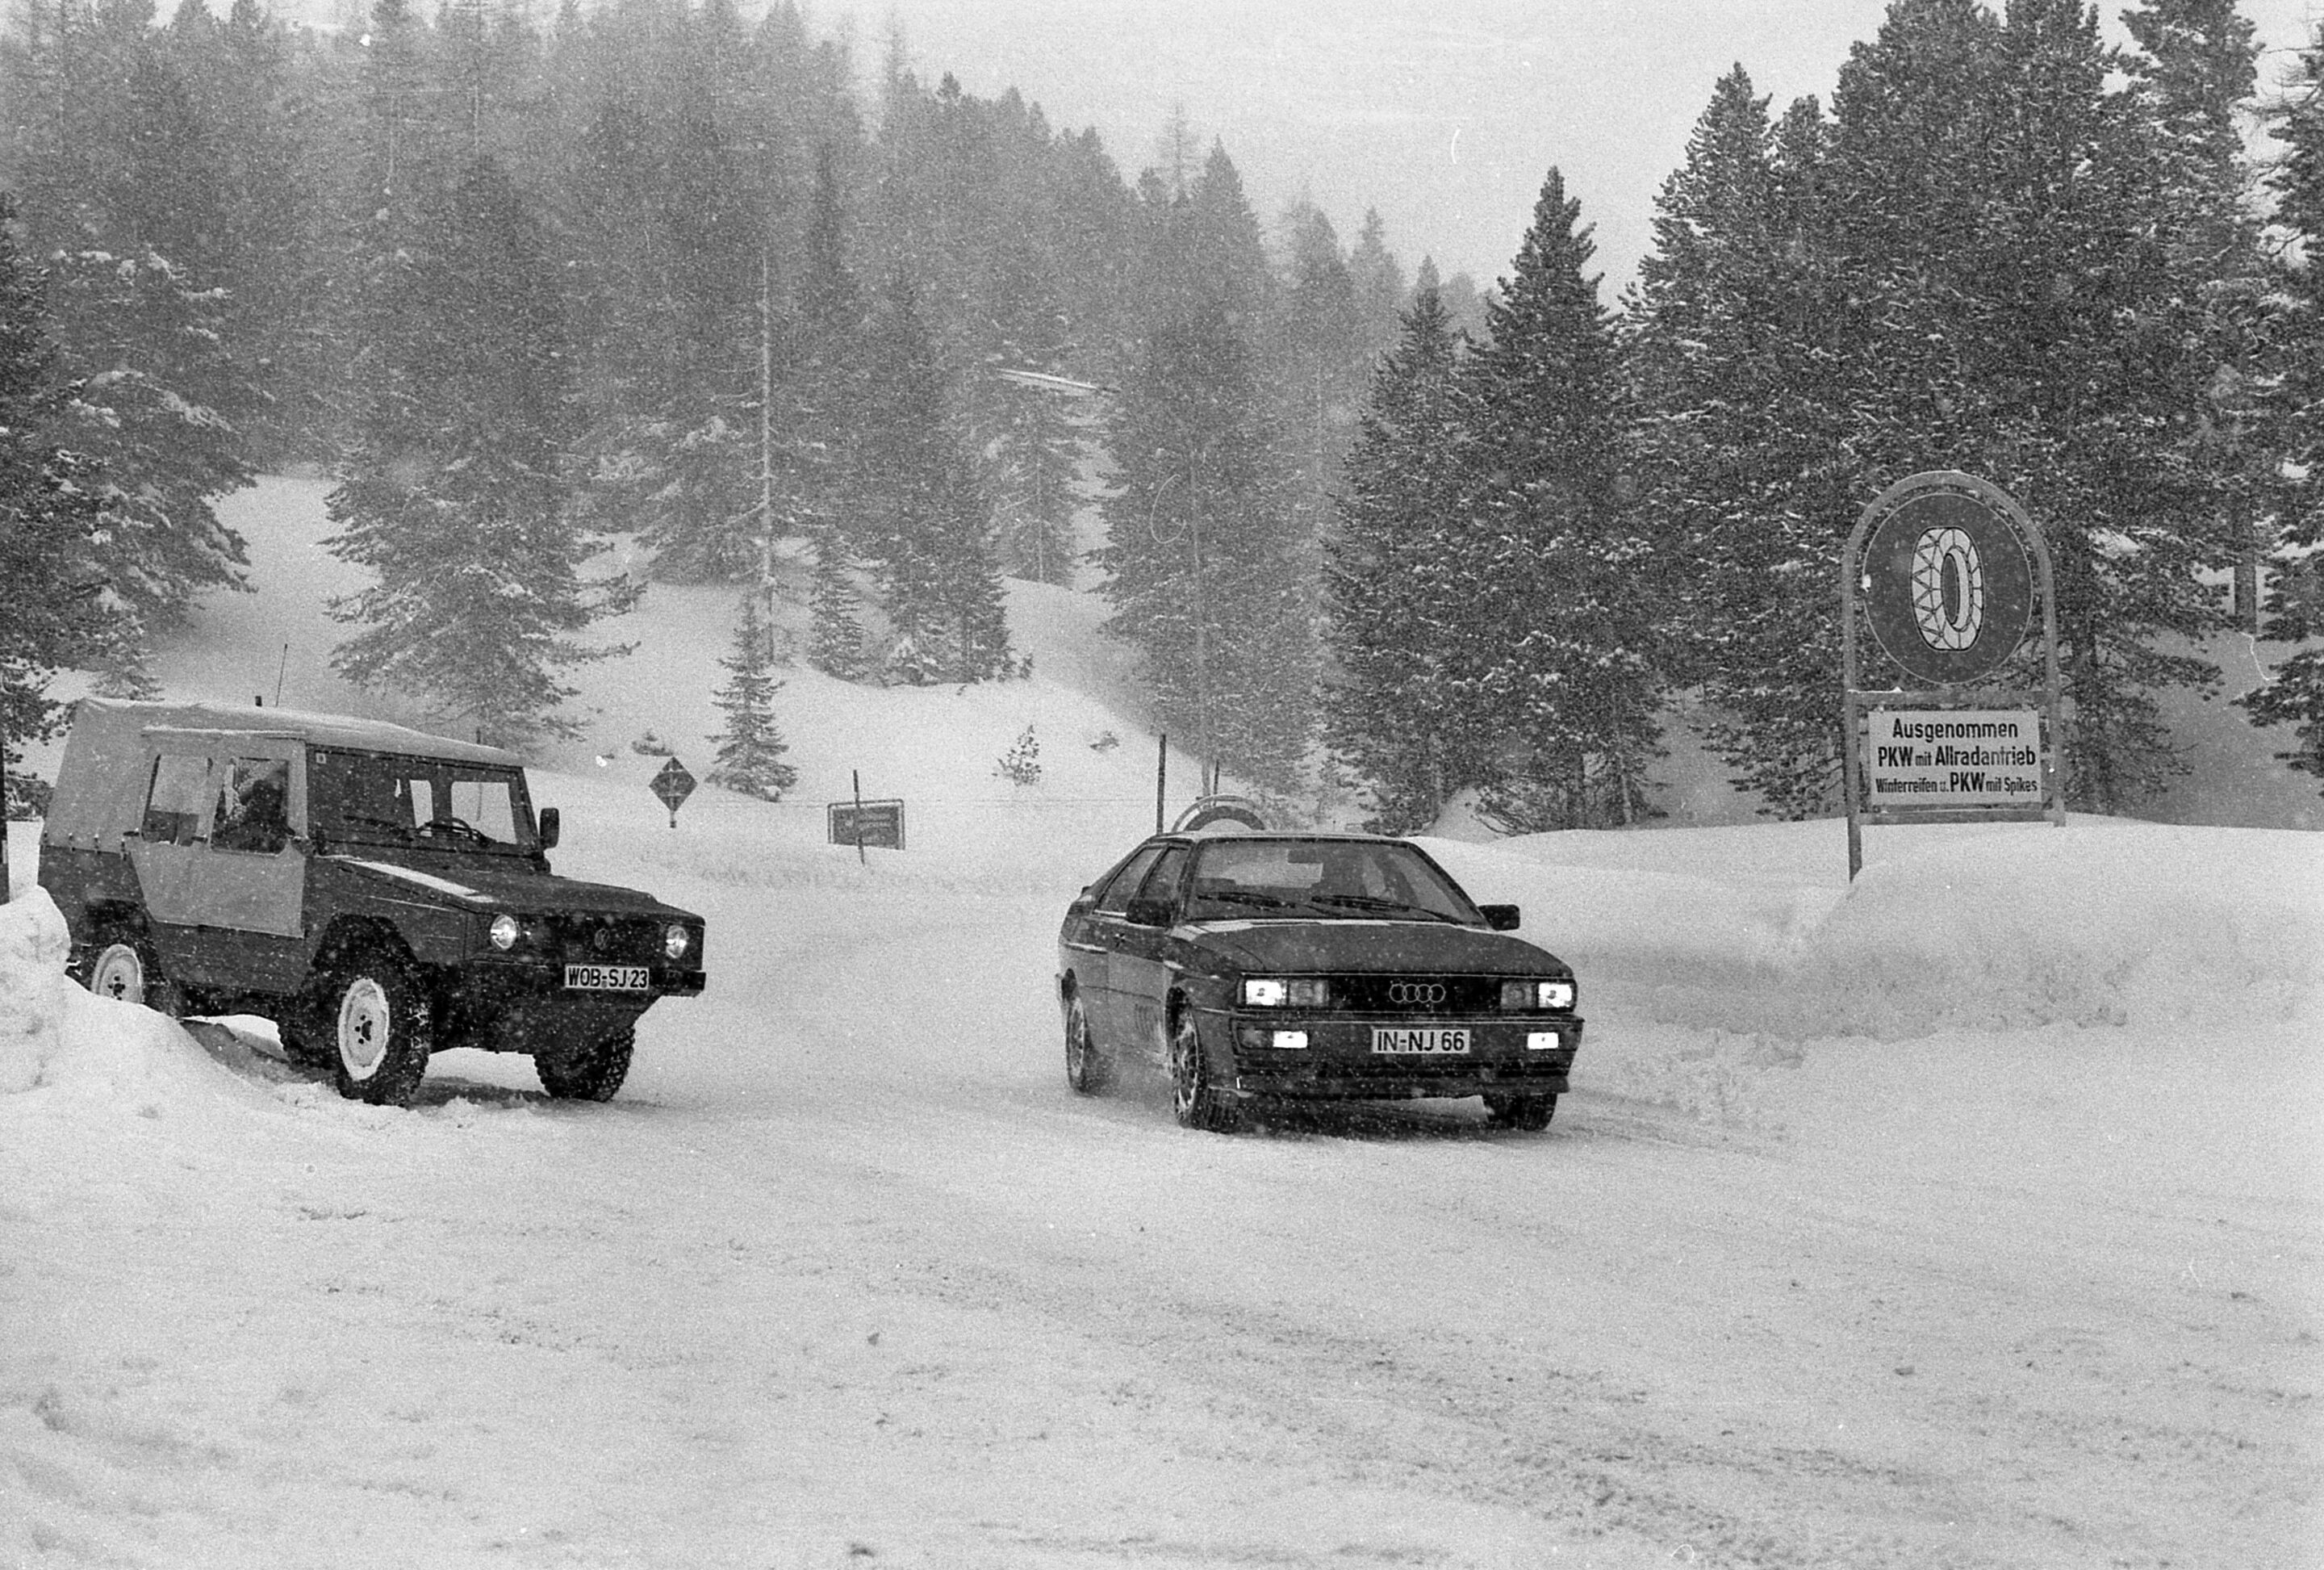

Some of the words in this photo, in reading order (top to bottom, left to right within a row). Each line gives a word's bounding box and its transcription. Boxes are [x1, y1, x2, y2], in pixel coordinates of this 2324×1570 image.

[1892, 718, 2017, 743] Ausgenommen
[1878, 747, 1913, 767] PKW
[1916, 752, 1932, 766] mit
[1935, 745, 2035, 766] Allradantrieb
[1875, 777, 1937, 793] Winterreifen
[1950, 772, 1985, 792] PKW
[1986, 777, 2001, 793] mit
[2004, 777, 2038, 796] Spikes
[1377, 1031, 1434, 1051] IN-NJ
[1441, 1031, 1465, 1051] 66
